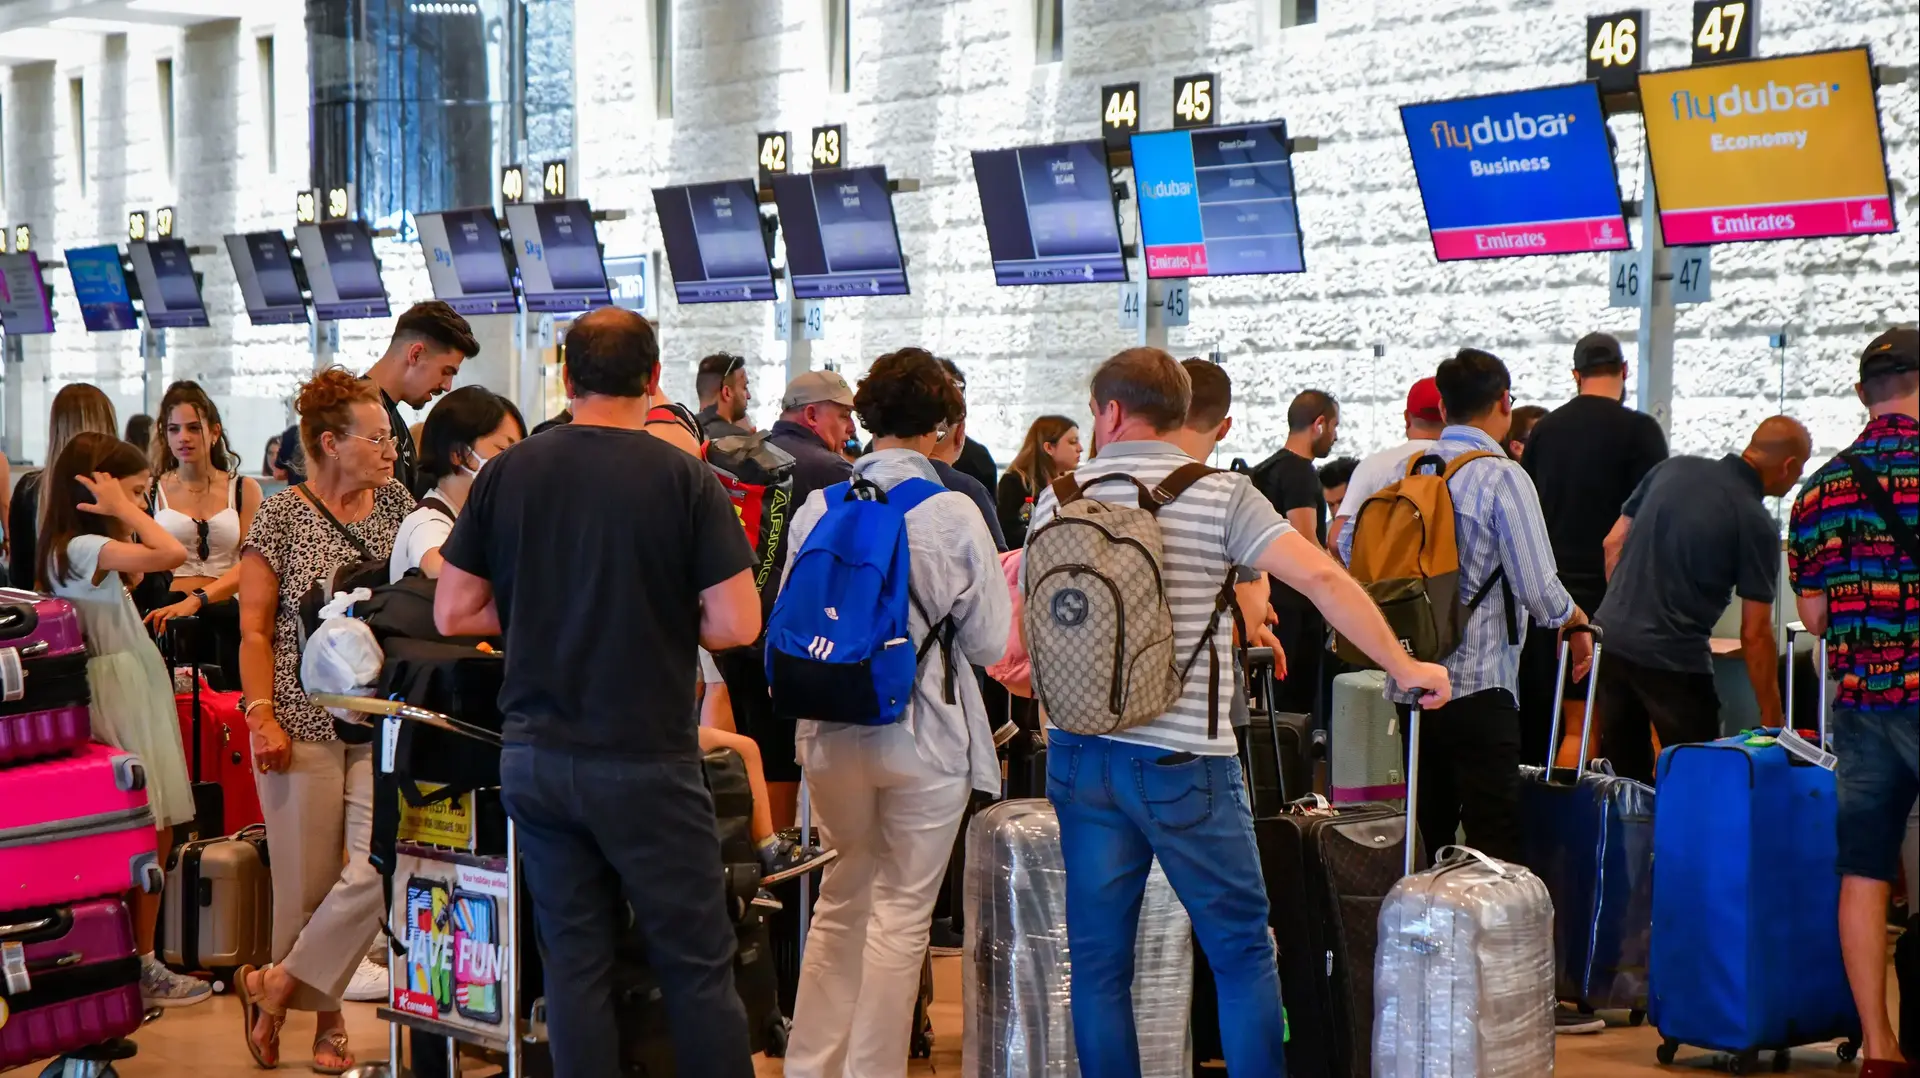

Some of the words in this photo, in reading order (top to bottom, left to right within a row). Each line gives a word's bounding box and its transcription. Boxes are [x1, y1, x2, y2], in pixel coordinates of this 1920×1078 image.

[1590, 18, 1637, 68] 46
[1697, 2, 1745, 54] 47
[1105, 90, 1137, 128] 44
[1176, 80, 1211, 121] 45
[1670, 79, 1841, 123] flydubai
[813, 129, 840, 164] 43
[1429, 111, 1576, 151] flydubai
[1710, 130, 1808, 153] Economy
[760, 136, 786, 170] 42
[1469, 156, 1551, 177] Business
[502, 168, 522, 199] 40
[544, 163, 564, 195] 41
[1711, 212, 1796, 236] Emirates
[434, 246, 451, 267] Sky
[524, 239, 543, 262] Sky
[1474, 230, 1547, 251] Emirates
[1149, 253, 1191, 270] Emirates
[1679, 257, 1703, 292] 47
[1616, 262, 1639, 297] 46
[1123, 291, 1139, 319] 44
[1167, 288, 1184, 317] 45
[807, 307, 821, 332] 43
[755, 489, 787, 592] ARMO
[401, 926, 455, 971] HAVE
[406, 1001, 434, 1014] corendon
